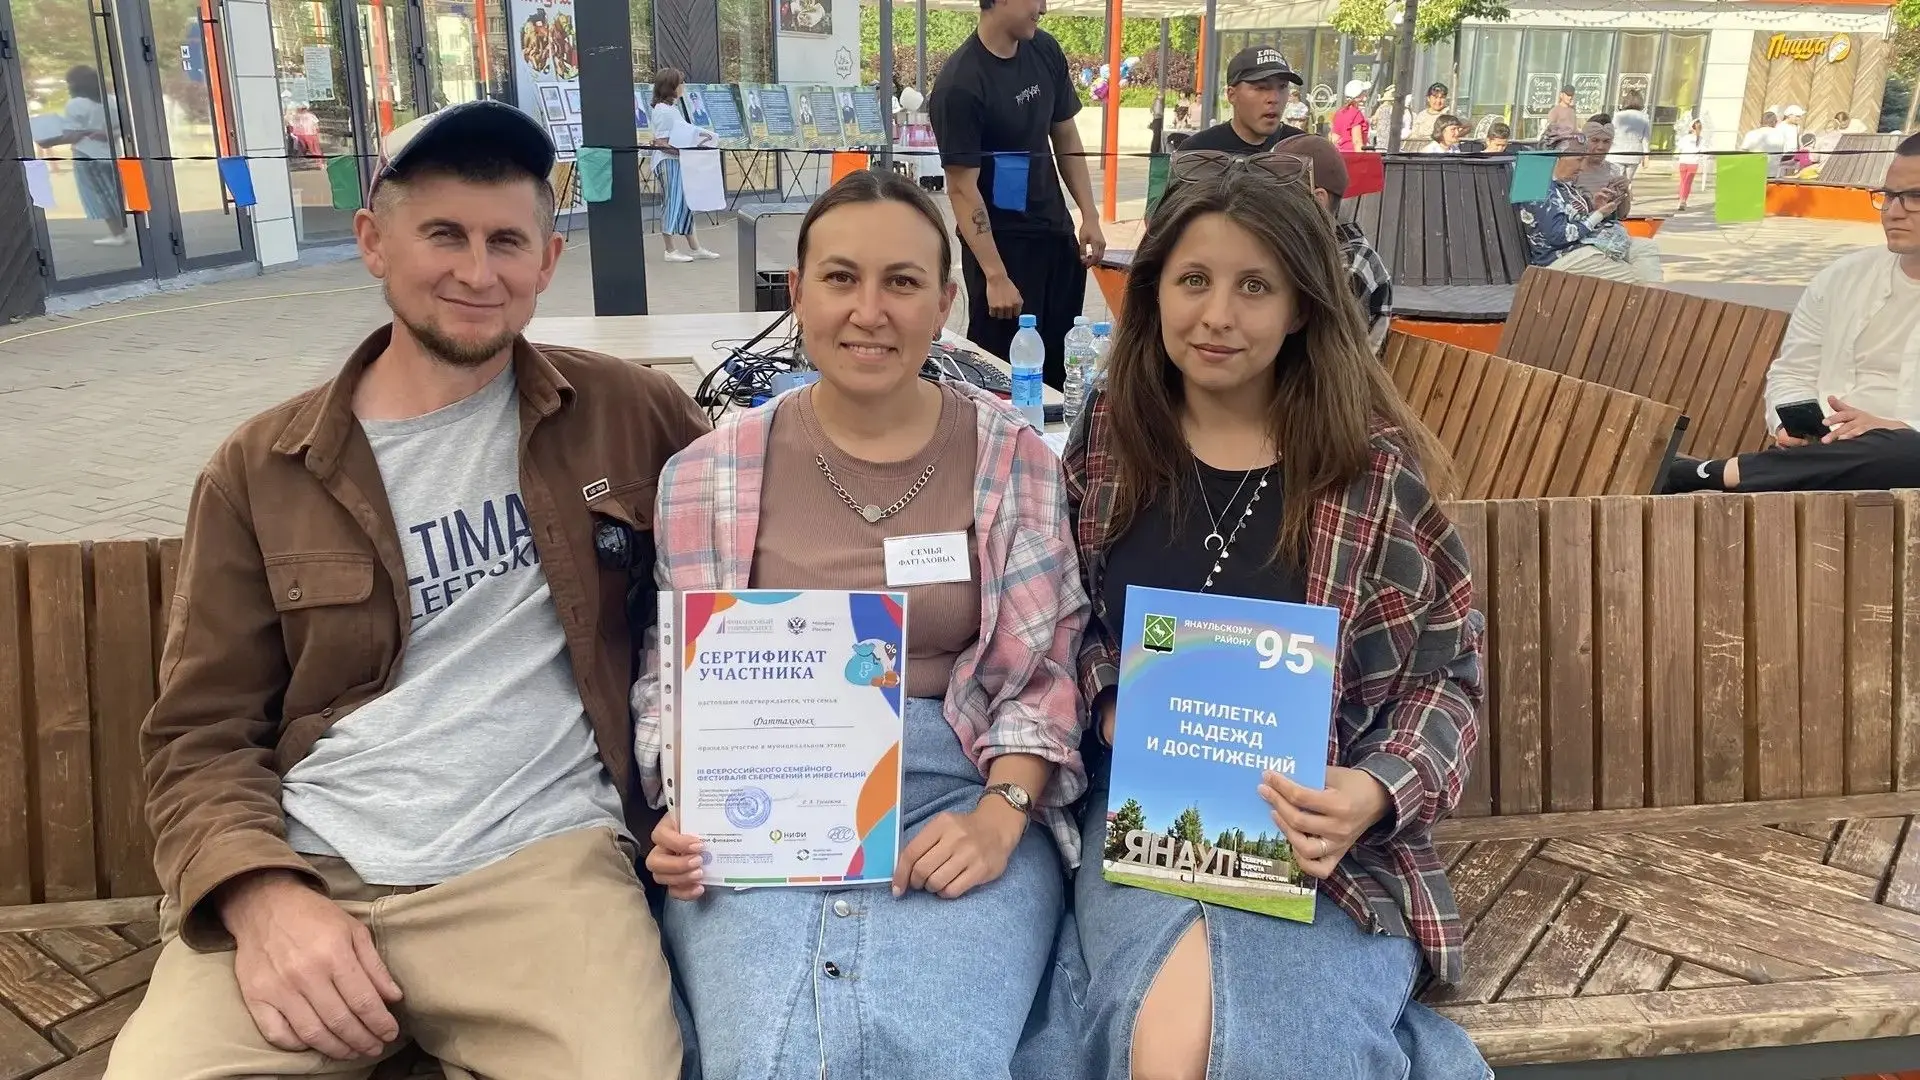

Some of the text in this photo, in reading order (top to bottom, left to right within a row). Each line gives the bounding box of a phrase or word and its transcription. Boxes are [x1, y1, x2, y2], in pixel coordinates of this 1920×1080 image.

[1767, 33, 1826, 60] Пицца
[910, 547, 942, 556] СЕМЬЯ
[898, 555, 956, 566] ФАТТАХОВЫХ
[1184, 620, 1253, 634] ЯНАУЛЬСКОМУ
[1214, 634, 1252, 647] РАЙОНУ
[700, 649, 827, 664] СЕРТИФИКАТ
[1255, 629, 1315, 674] 95
[699, 666, 815, 681] УЧАСТНИКА
[1170, 697, 1278, 727] ПЯТИЛЕТКА
[753, 716, 815, 726] Фаттаховых
[1180, 720, 1264, 750] НАДЕЖД
[1146, 736, 1296, 774] И ДОСТИЖЕНИЙ
[697, 774, 748, 782] ФЕСТИВАЛЯ
[749, 772, 804, 780] СБЕРЕЖЕНИЙ
[812, 771, 867, 780] ИНВЕСТИЦИЙ
[706, 766, 782, 775] ВСЕРОССИЙСКОГО
[783, 765, 832, 773] СЕМЕЙНОГО
[783, 831, 807, 839] НИФИ
[1118, 829, 1237, 877] ЯНАУЛ
